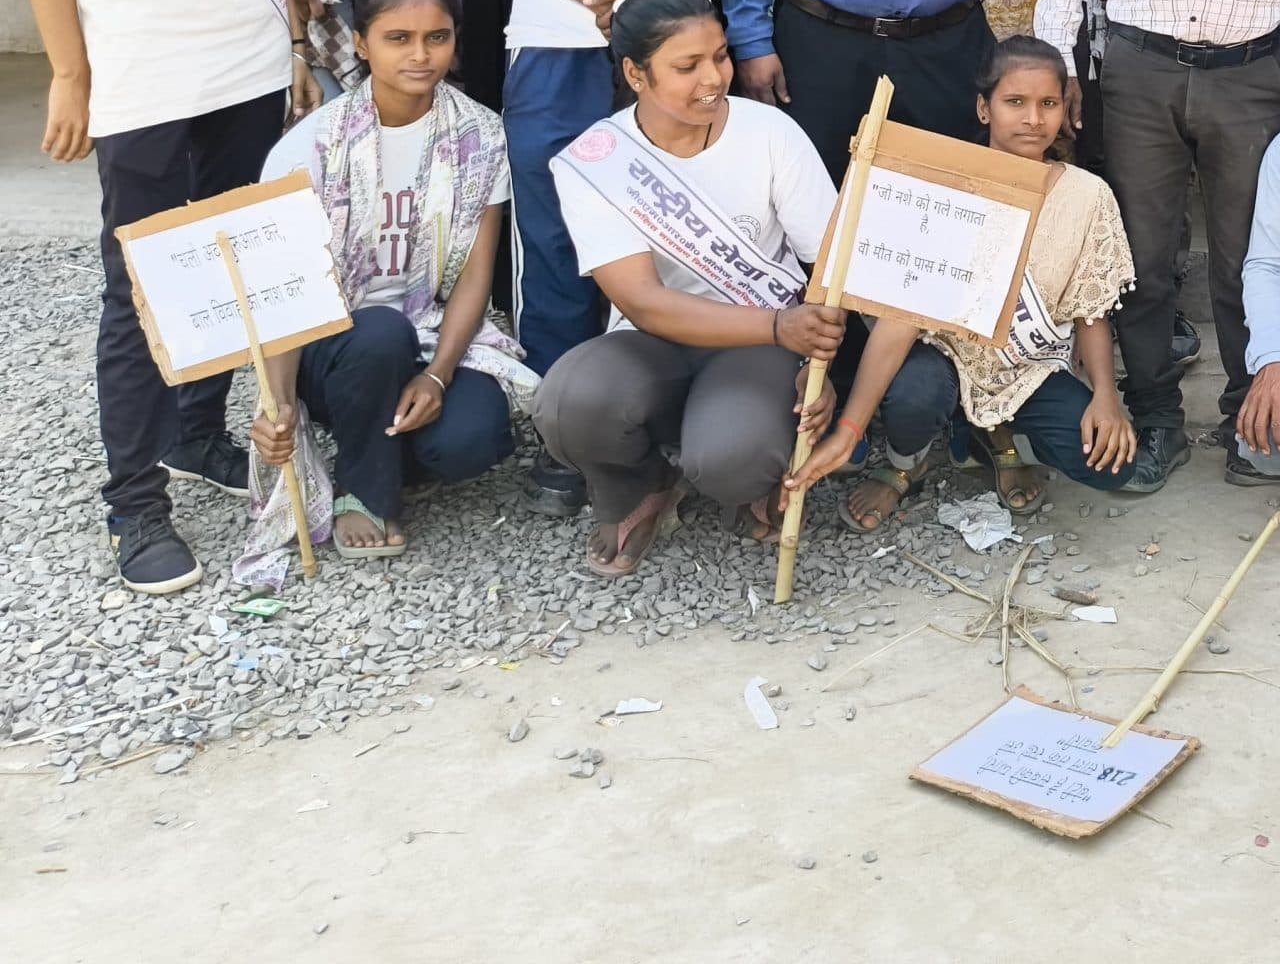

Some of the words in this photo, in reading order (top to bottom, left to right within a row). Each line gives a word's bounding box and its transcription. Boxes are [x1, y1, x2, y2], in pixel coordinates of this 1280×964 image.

[628, 157, 712, 239] राष्ट्रीय
[710, 236, 767, 284] सेवा
[894, 190, 912, 207] नशे
[915, 193, 931, 212] को
[933, 199, 951, 217] गले
[953, 204, 987, 228] लगाता
[857, 239, 871, 256] वो
[873, 242, 892, 263] मौत
[896, 248, 912, 269] को
[913, 256, 936, 275] पास
[937, 258, 949, 278] में
[950, 265, 974, 285] पाता
